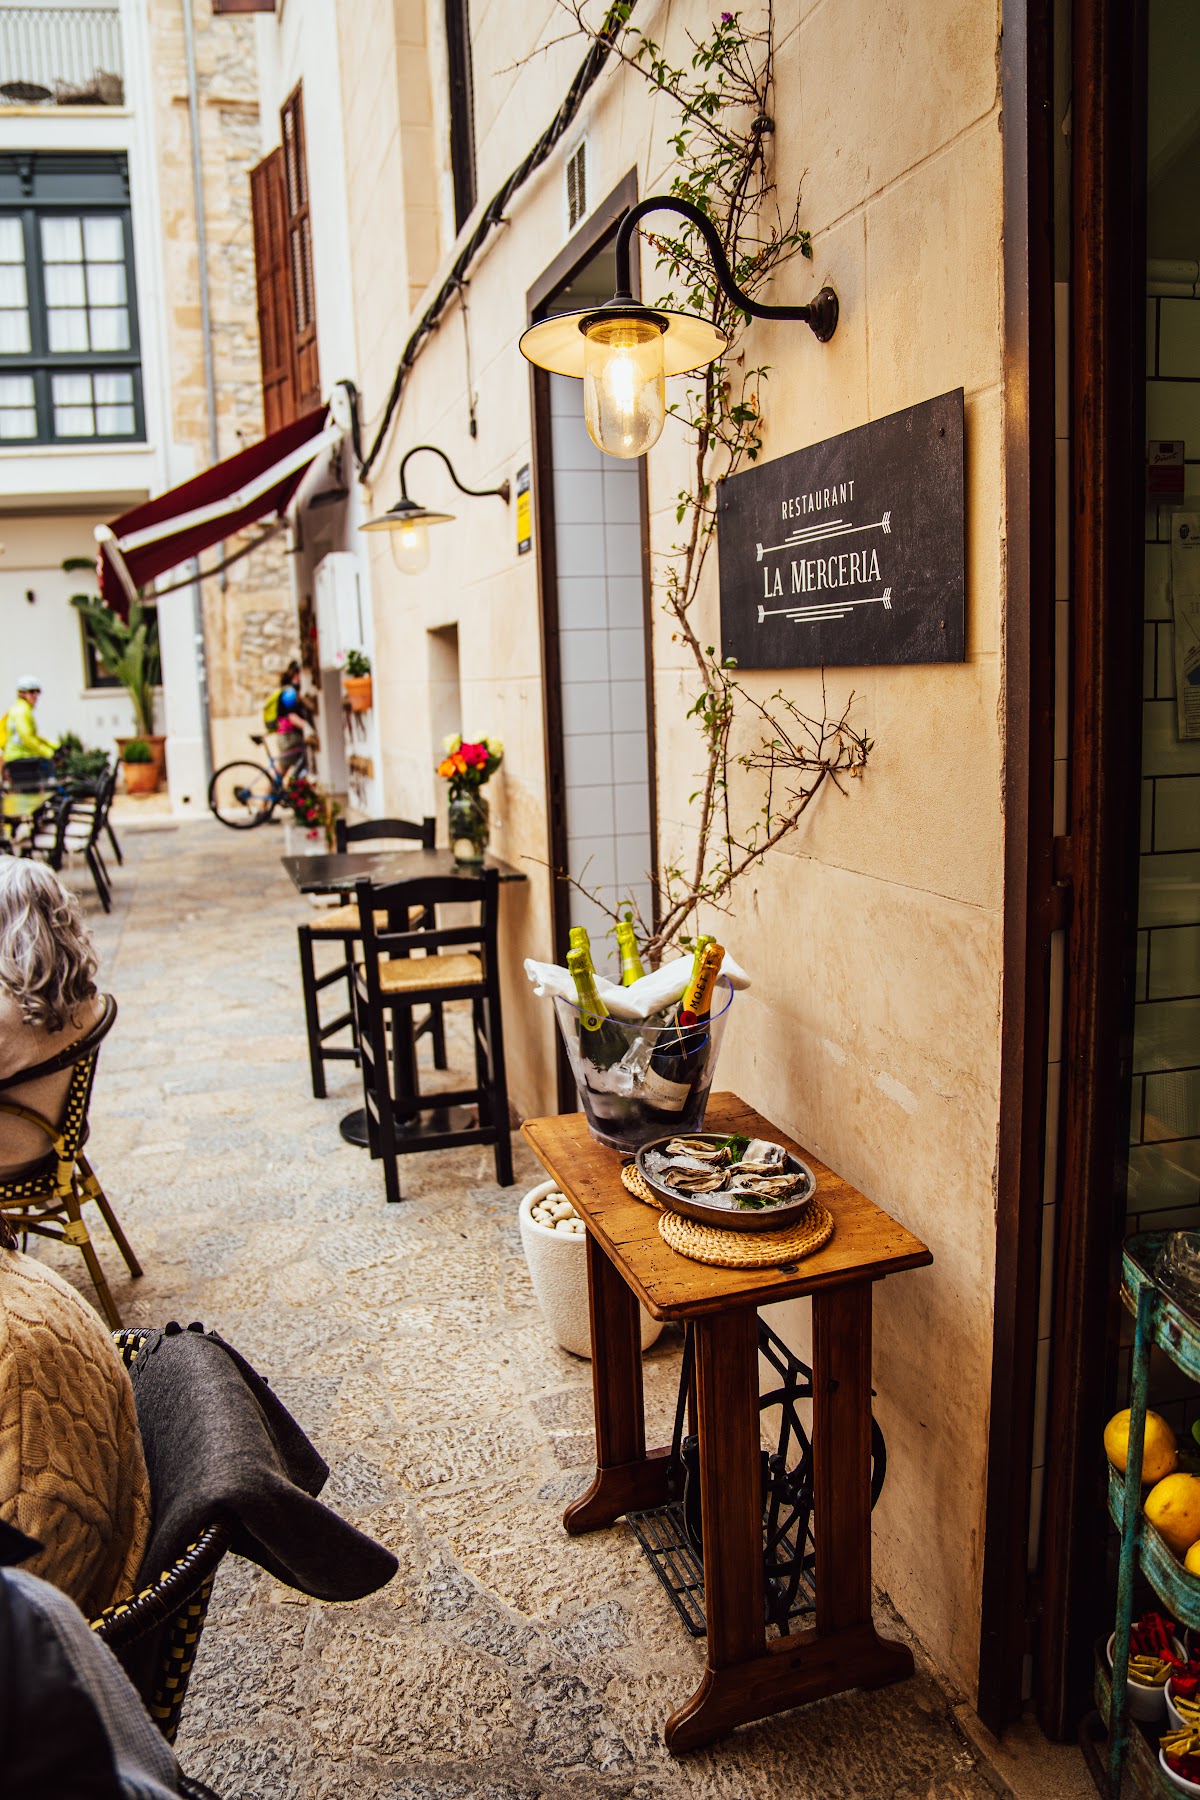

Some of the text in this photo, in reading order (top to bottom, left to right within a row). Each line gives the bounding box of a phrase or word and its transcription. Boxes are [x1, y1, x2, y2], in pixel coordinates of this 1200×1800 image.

[781, 480, 855, 520] RESTAURANT
[763, 548, 882, 598] LA MERCERIA
